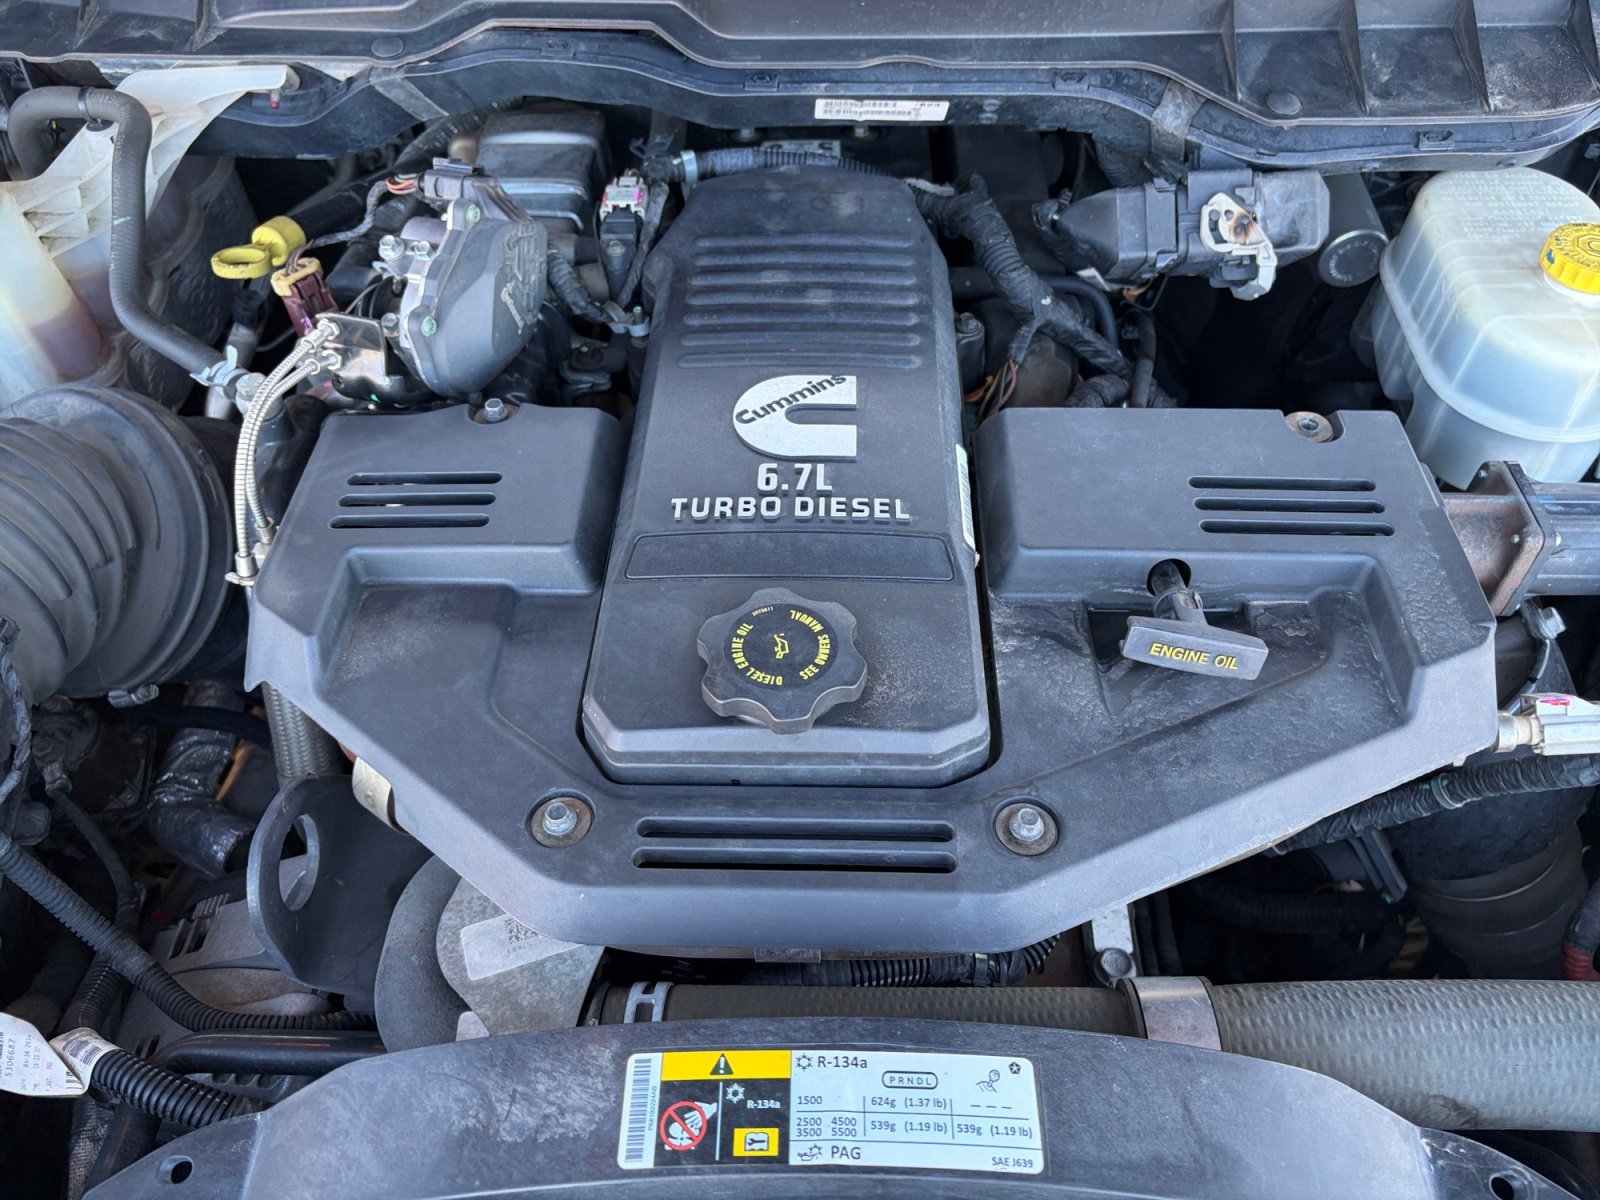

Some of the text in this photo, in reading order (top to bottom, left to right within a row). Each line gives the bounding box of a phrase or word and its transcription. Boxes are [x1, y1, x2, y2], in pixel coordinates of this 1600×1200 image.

[735, 374, 847, 425] Cummins
[757, 463, 833, 494] 6.7L
[671, 496, 911, 523] TURBO DIESEL
[790, 610, 830, 680] SEE OWNERS MANUAL
[731, 623, 783, 685] DIESEL ENGINE OIL
[1149, 642, 1239, 670] ENGINE OIL
[5, 1038, 16, 1078] 5306687
[818, 1056, 868, 1069] R-134a
[747, 1100, 781, 1109] R-134a
[797, 1095, 947, 1109] 1500 624g (1.37 lb)
[796, 1116, 857, 1127] 2500 4500
[870, 1120, 948, 1134] 539g (1.19 lb)
[796, 1127, 857, 1137] 3500 5500
[956, 1124, 1033, 1139] 539g (1.19 lb)
[831, 1145, 862, 1160] PAG
[991, 1156, 1034, 1168] SAE J639
